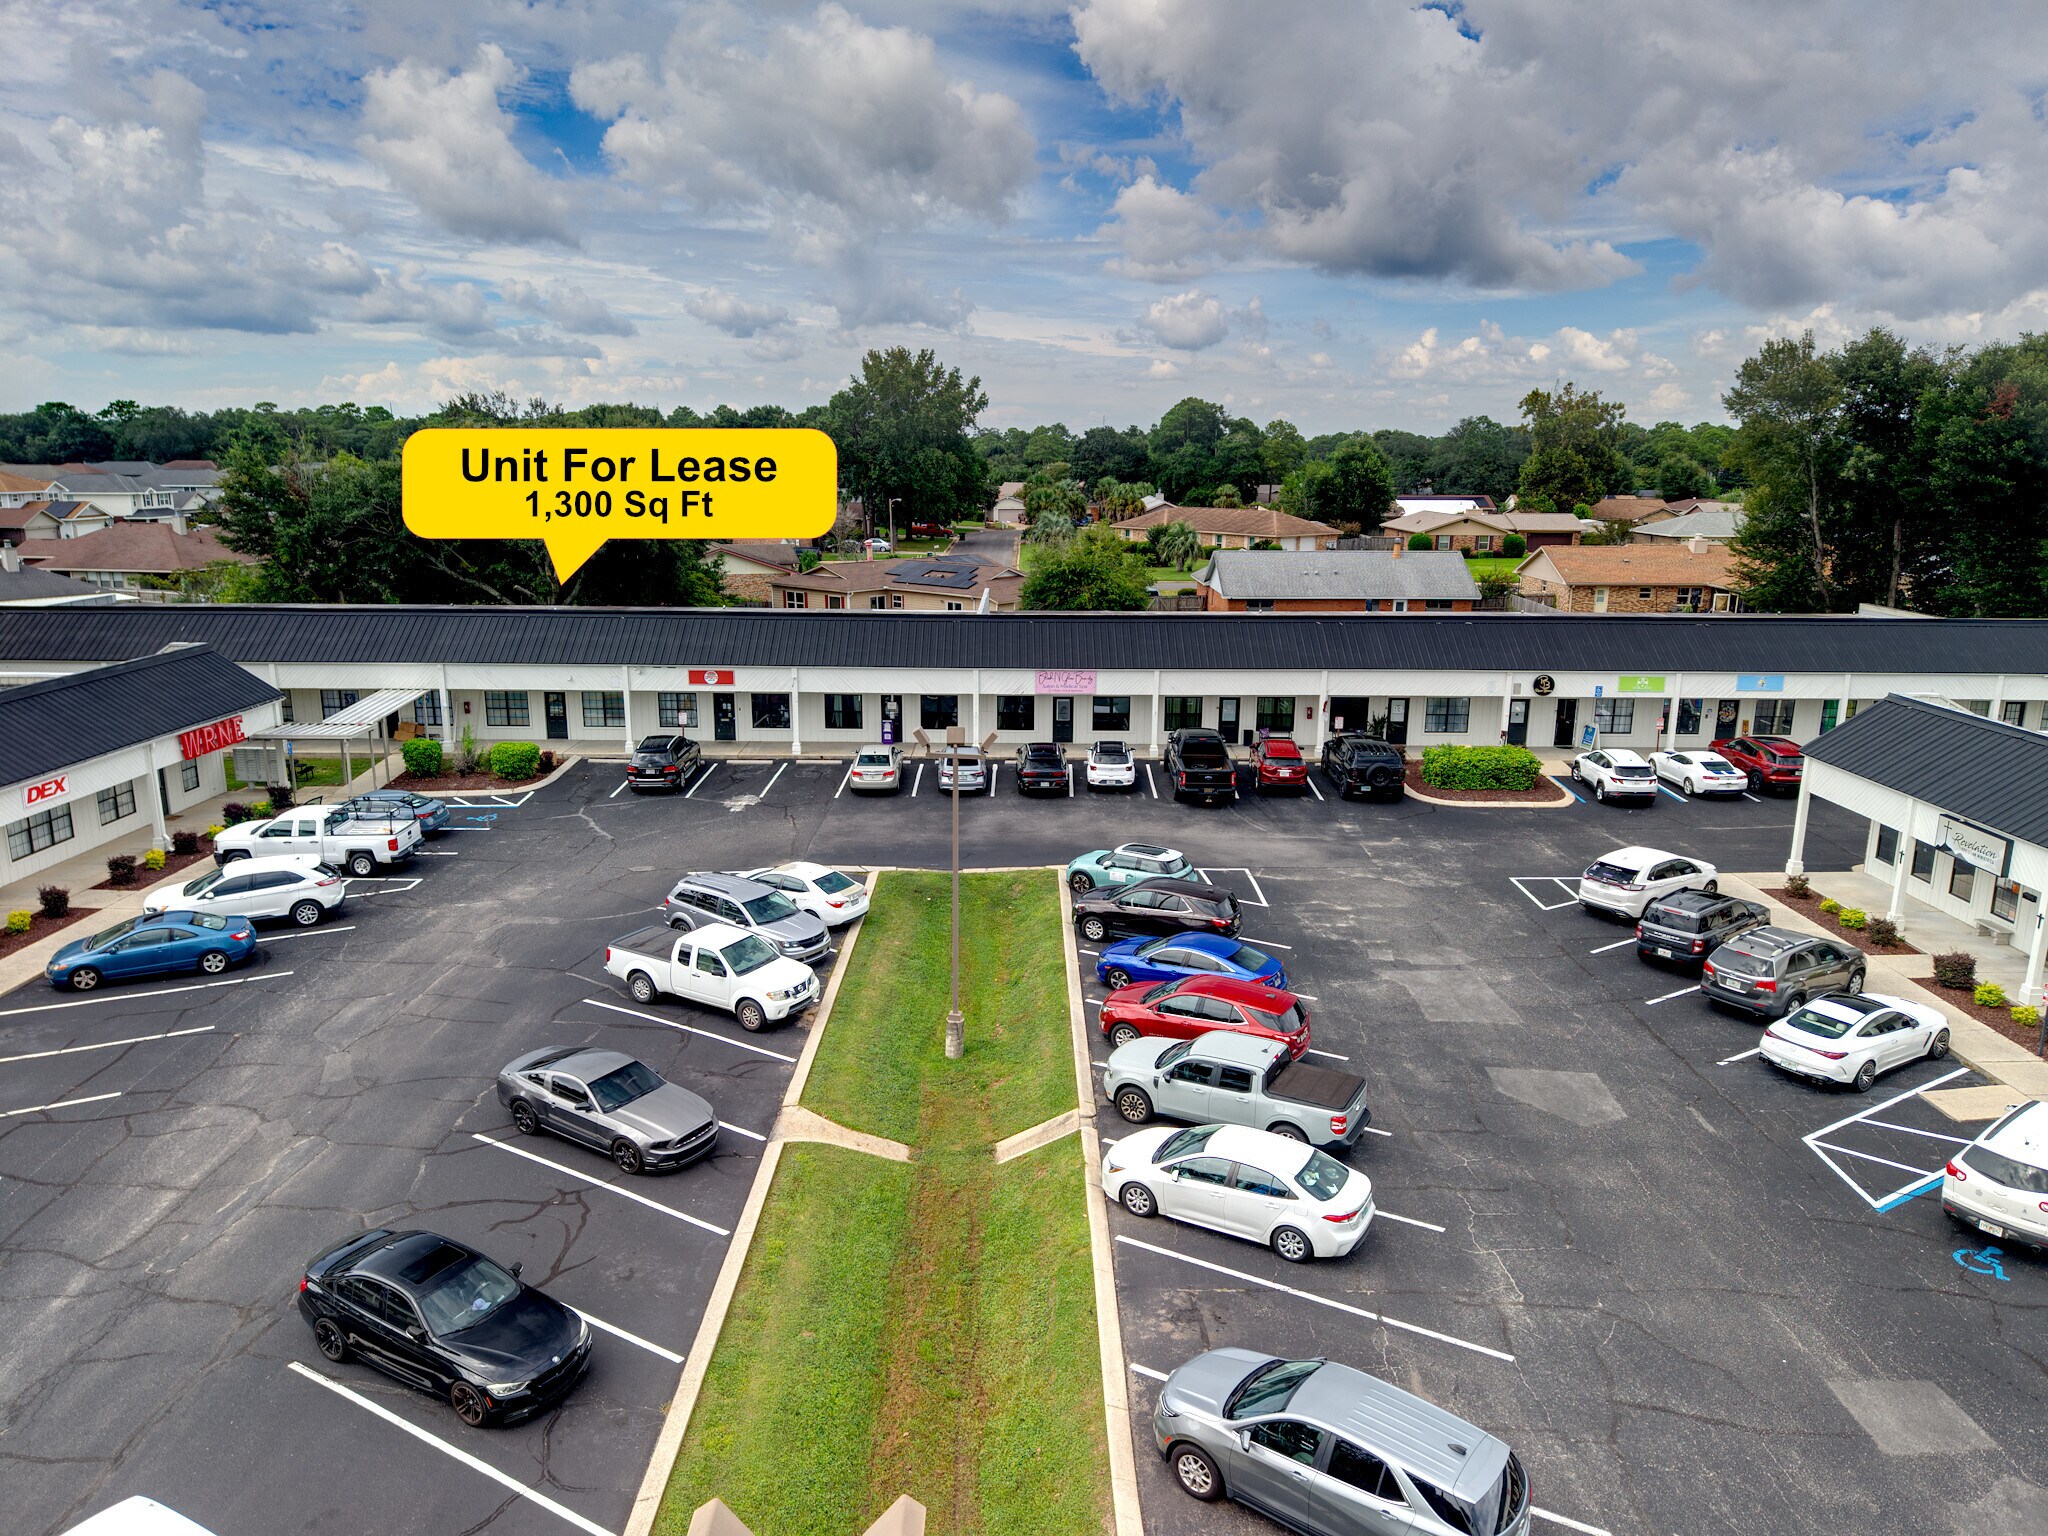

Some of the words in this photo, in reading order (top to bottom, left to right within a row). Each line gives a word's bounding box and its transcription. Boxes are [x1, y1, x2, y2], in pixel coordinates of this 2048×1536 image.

[180, 715, 245, 760] WRNE
[27, 776, 66, 804] DEX
[1952, 832, 1998, 859] Revelation
